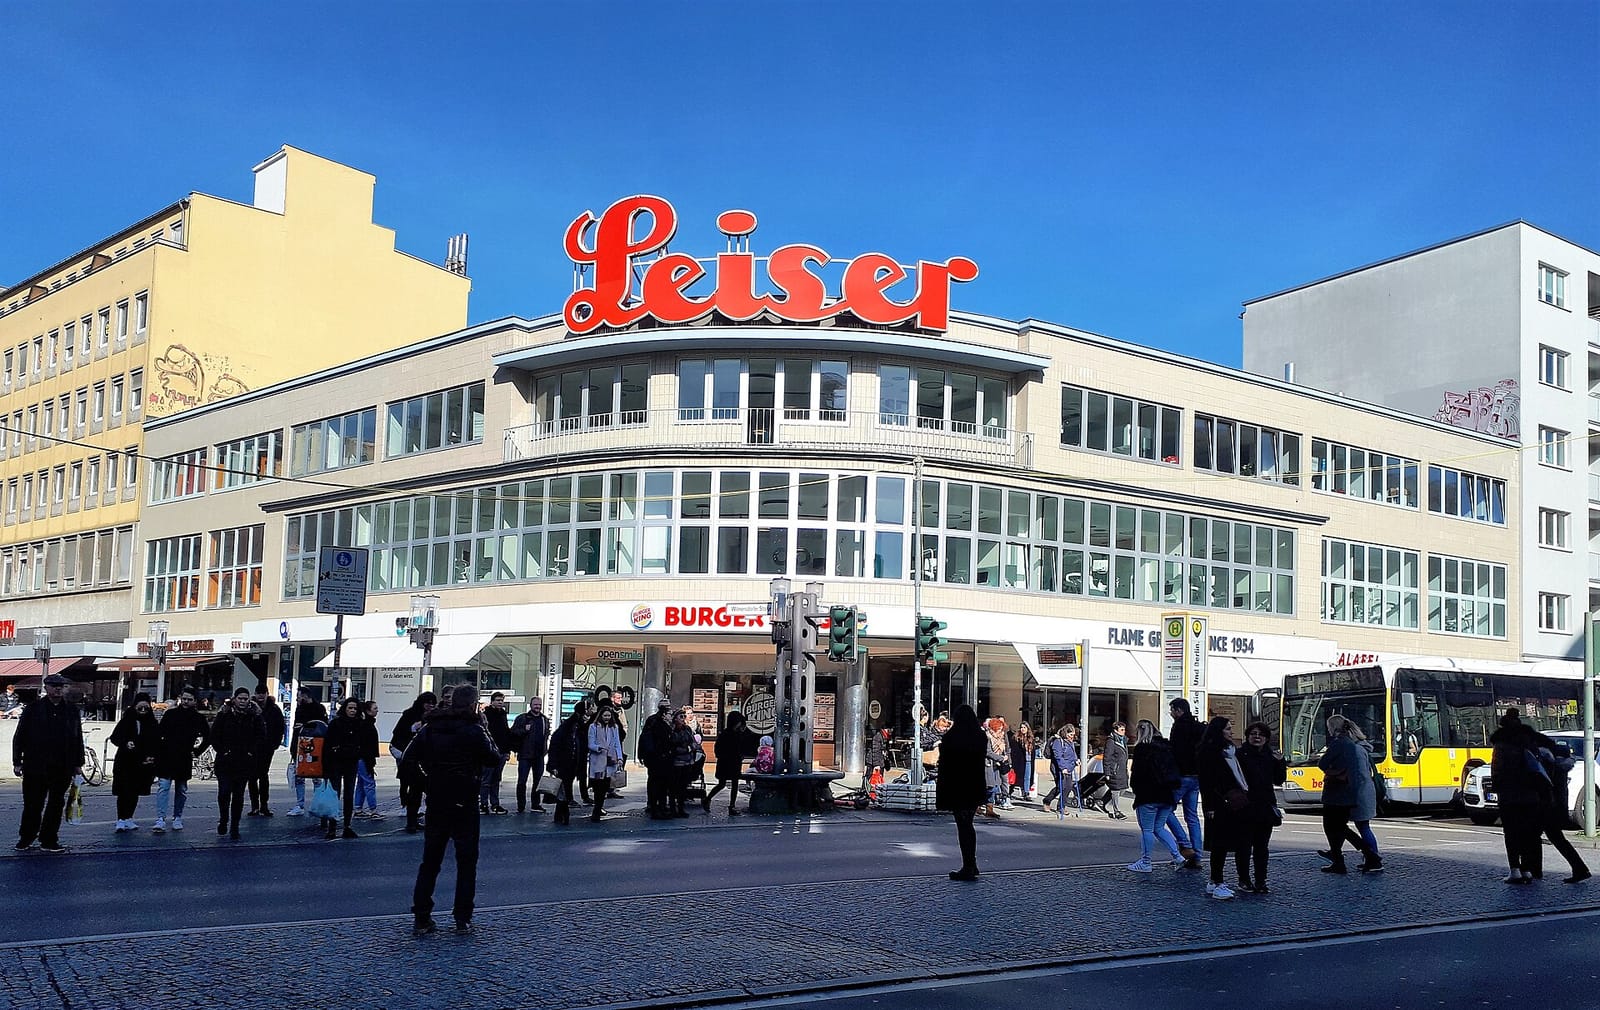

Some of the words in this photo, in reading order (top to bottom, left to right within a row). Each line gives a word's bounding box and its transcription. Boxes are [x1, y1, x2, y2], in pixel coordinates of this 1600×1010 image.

[563, 194, 979, 334] Leiser
[632, 607, 651, 618] BURGER
[633, 613, 652, 624] KING
[664, 606, 764, 627] BURGER
[1108, 627, 1144, 646] FLAME
[1209, 636, 1227, 652] NCE
[1231, 637, 1254, 653] 1954
[597, 649, 642, 660] opensmile
[746, 699, 775, 714] BURGE
[1312, 778, 1323, 788] be
